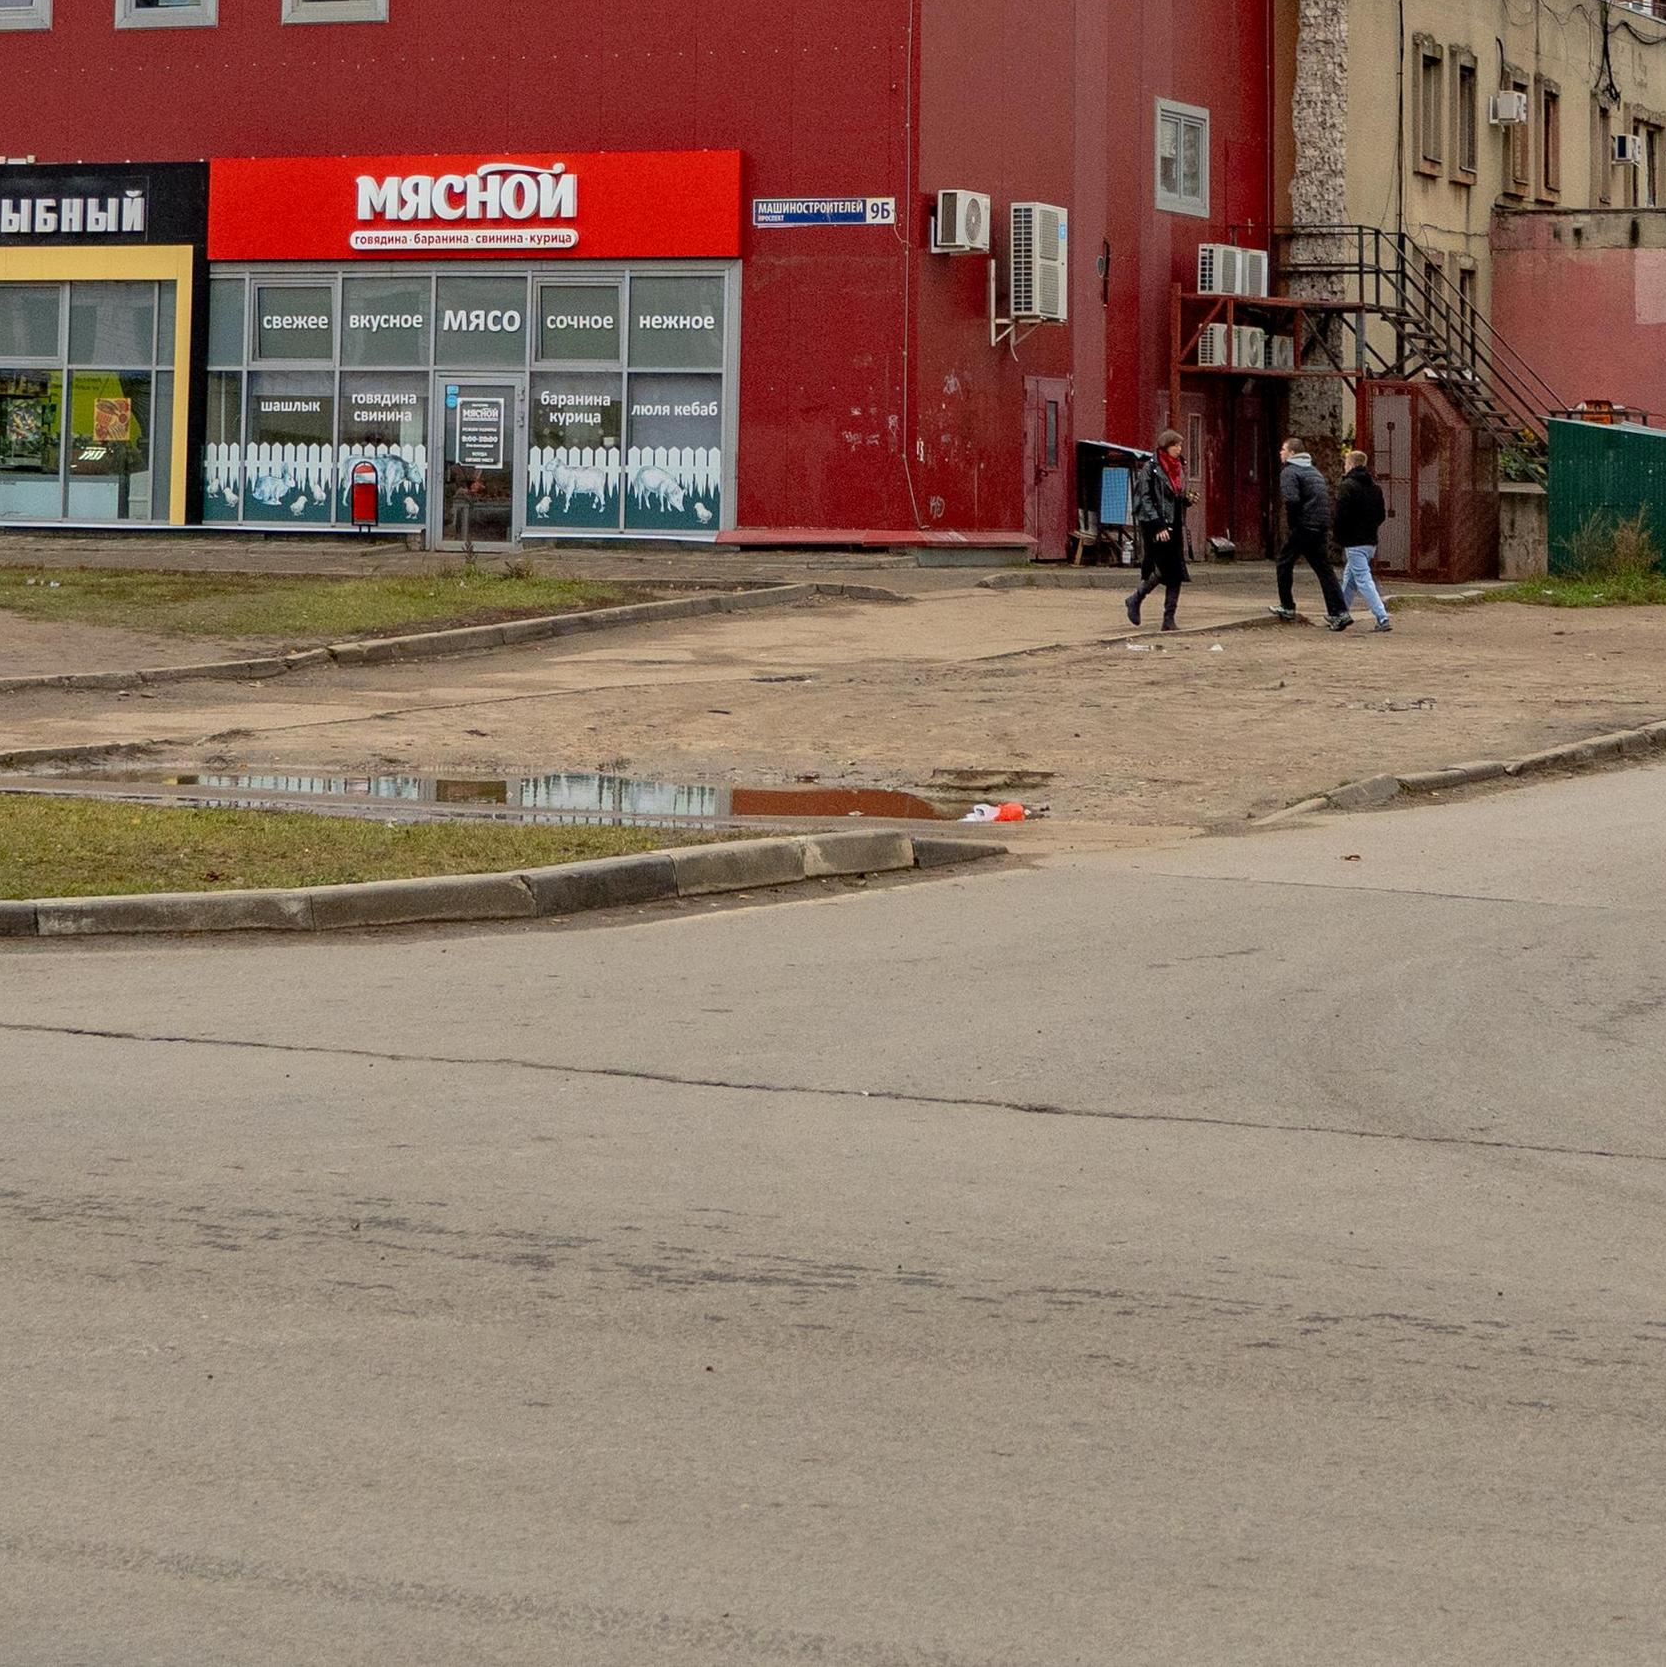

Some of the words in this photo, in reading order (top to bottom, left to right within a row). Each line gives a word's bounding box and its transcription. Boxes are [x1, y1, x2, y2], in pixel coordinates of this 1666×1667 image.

[355, 162, 577, 221] МЯСНОЙ
[758, 200, 863, 214] МАШИНОСТРОИТЕЛЕЙ
[870, 202, 891, 220] 9Б
[355, 236, 408, 245] говядина
[414, 233, 469, 246] баранина
[475, 234, 524, 244] свинина
[529, 234, 572, 246] курица
[262, 315, 329, 329] свежее
[349, 314, 423, 332] вкусное
[546, 315, 614, 329] сочное
[639, 315, 715, 330] нежное
[261, 401, 321, 412] шашлык
[351, 392, 417, 407] говядина
[540, 391, 611, 408] баранина
[354, 409, 413, 422] свинина
[631, 404, 670, 416] люля
[674, 401, 718, 416] кебаб
[549, 410, 602, 426] курица
